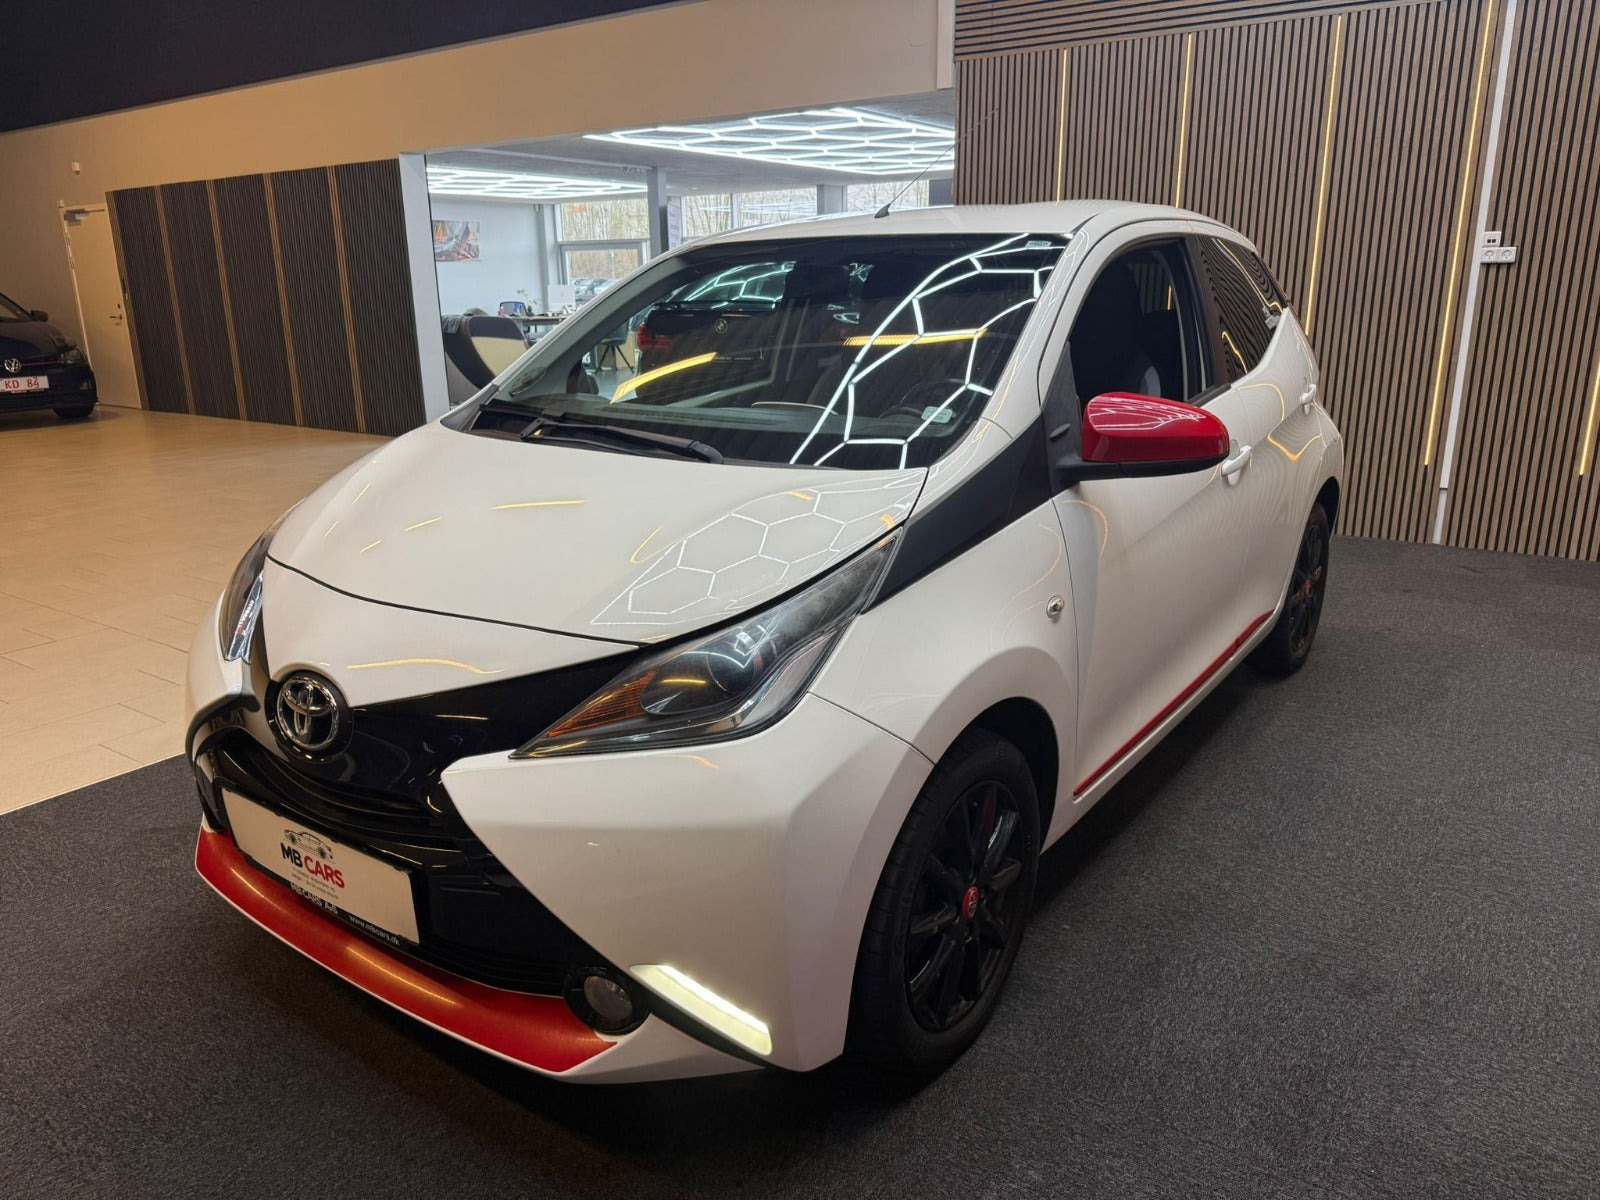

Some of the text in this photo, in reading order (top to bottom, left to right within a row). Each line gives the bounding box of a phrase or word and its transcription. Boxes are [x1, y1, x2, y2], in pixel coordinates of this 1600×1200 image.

[4, 379, 20, 389] KD
[280, 842, 303, 868] MB
[304, 855, 345, 889] CARS
